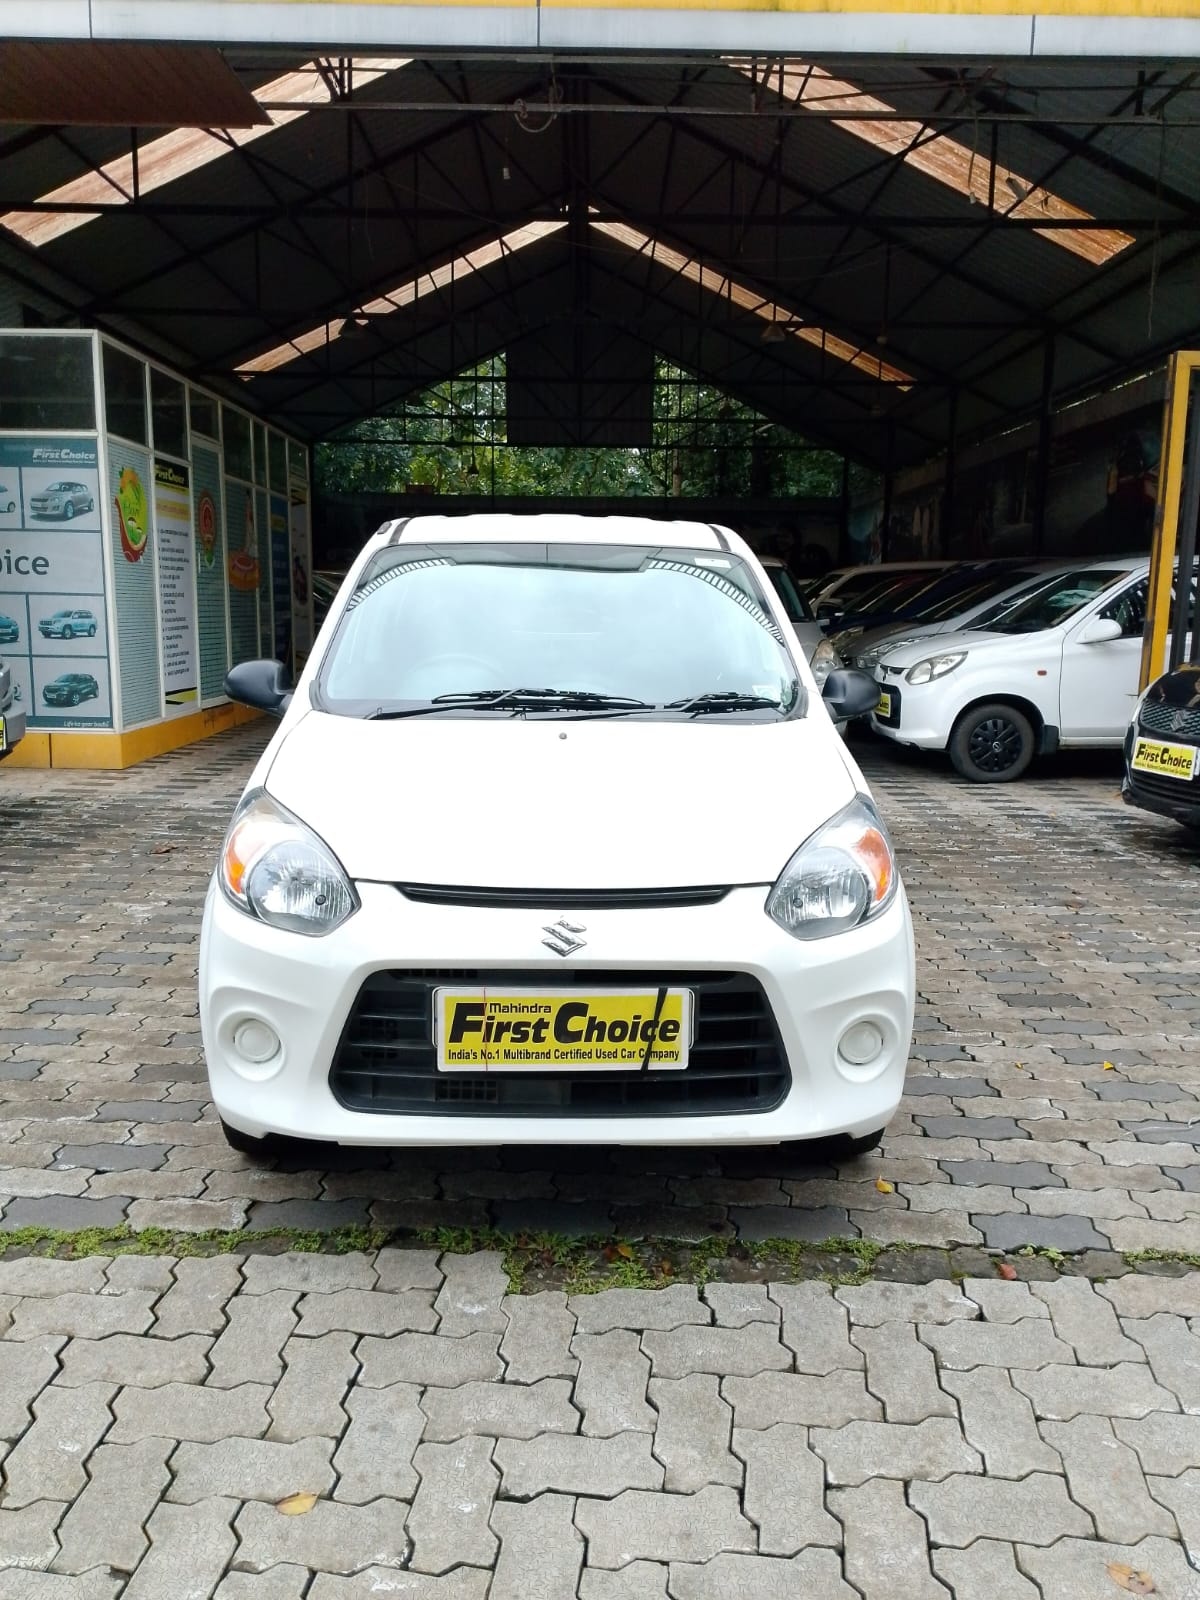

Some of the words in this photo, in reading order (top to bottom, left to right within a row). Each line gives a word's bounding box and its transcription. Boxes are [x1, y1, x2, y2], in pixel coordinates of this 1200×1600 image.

[33, 448, 60, 459] First
[60, 448, 95, 460] Choice
[0, 549, 49, 576] ice
[1136, 743, 1160, 763] First
[1160, 747, 1192, 769] Choice
[489, 1003, 552, 1013] Mahindra
[449, 1003, 550, 1044] First
[553, 1002, 681, 1044] Choice
[448, 1049, 478, 1060] India's
[480, 1049, 500, 1060] No.1
[503, 1049, 551, 1060] Multibrand
[554, 1048, 593, 1059] Certified
[595, 1049, 618, 1059] Used
[620, 1049, 636, 1059] Car
[639, 1049, 680, 1061] Cmpany
